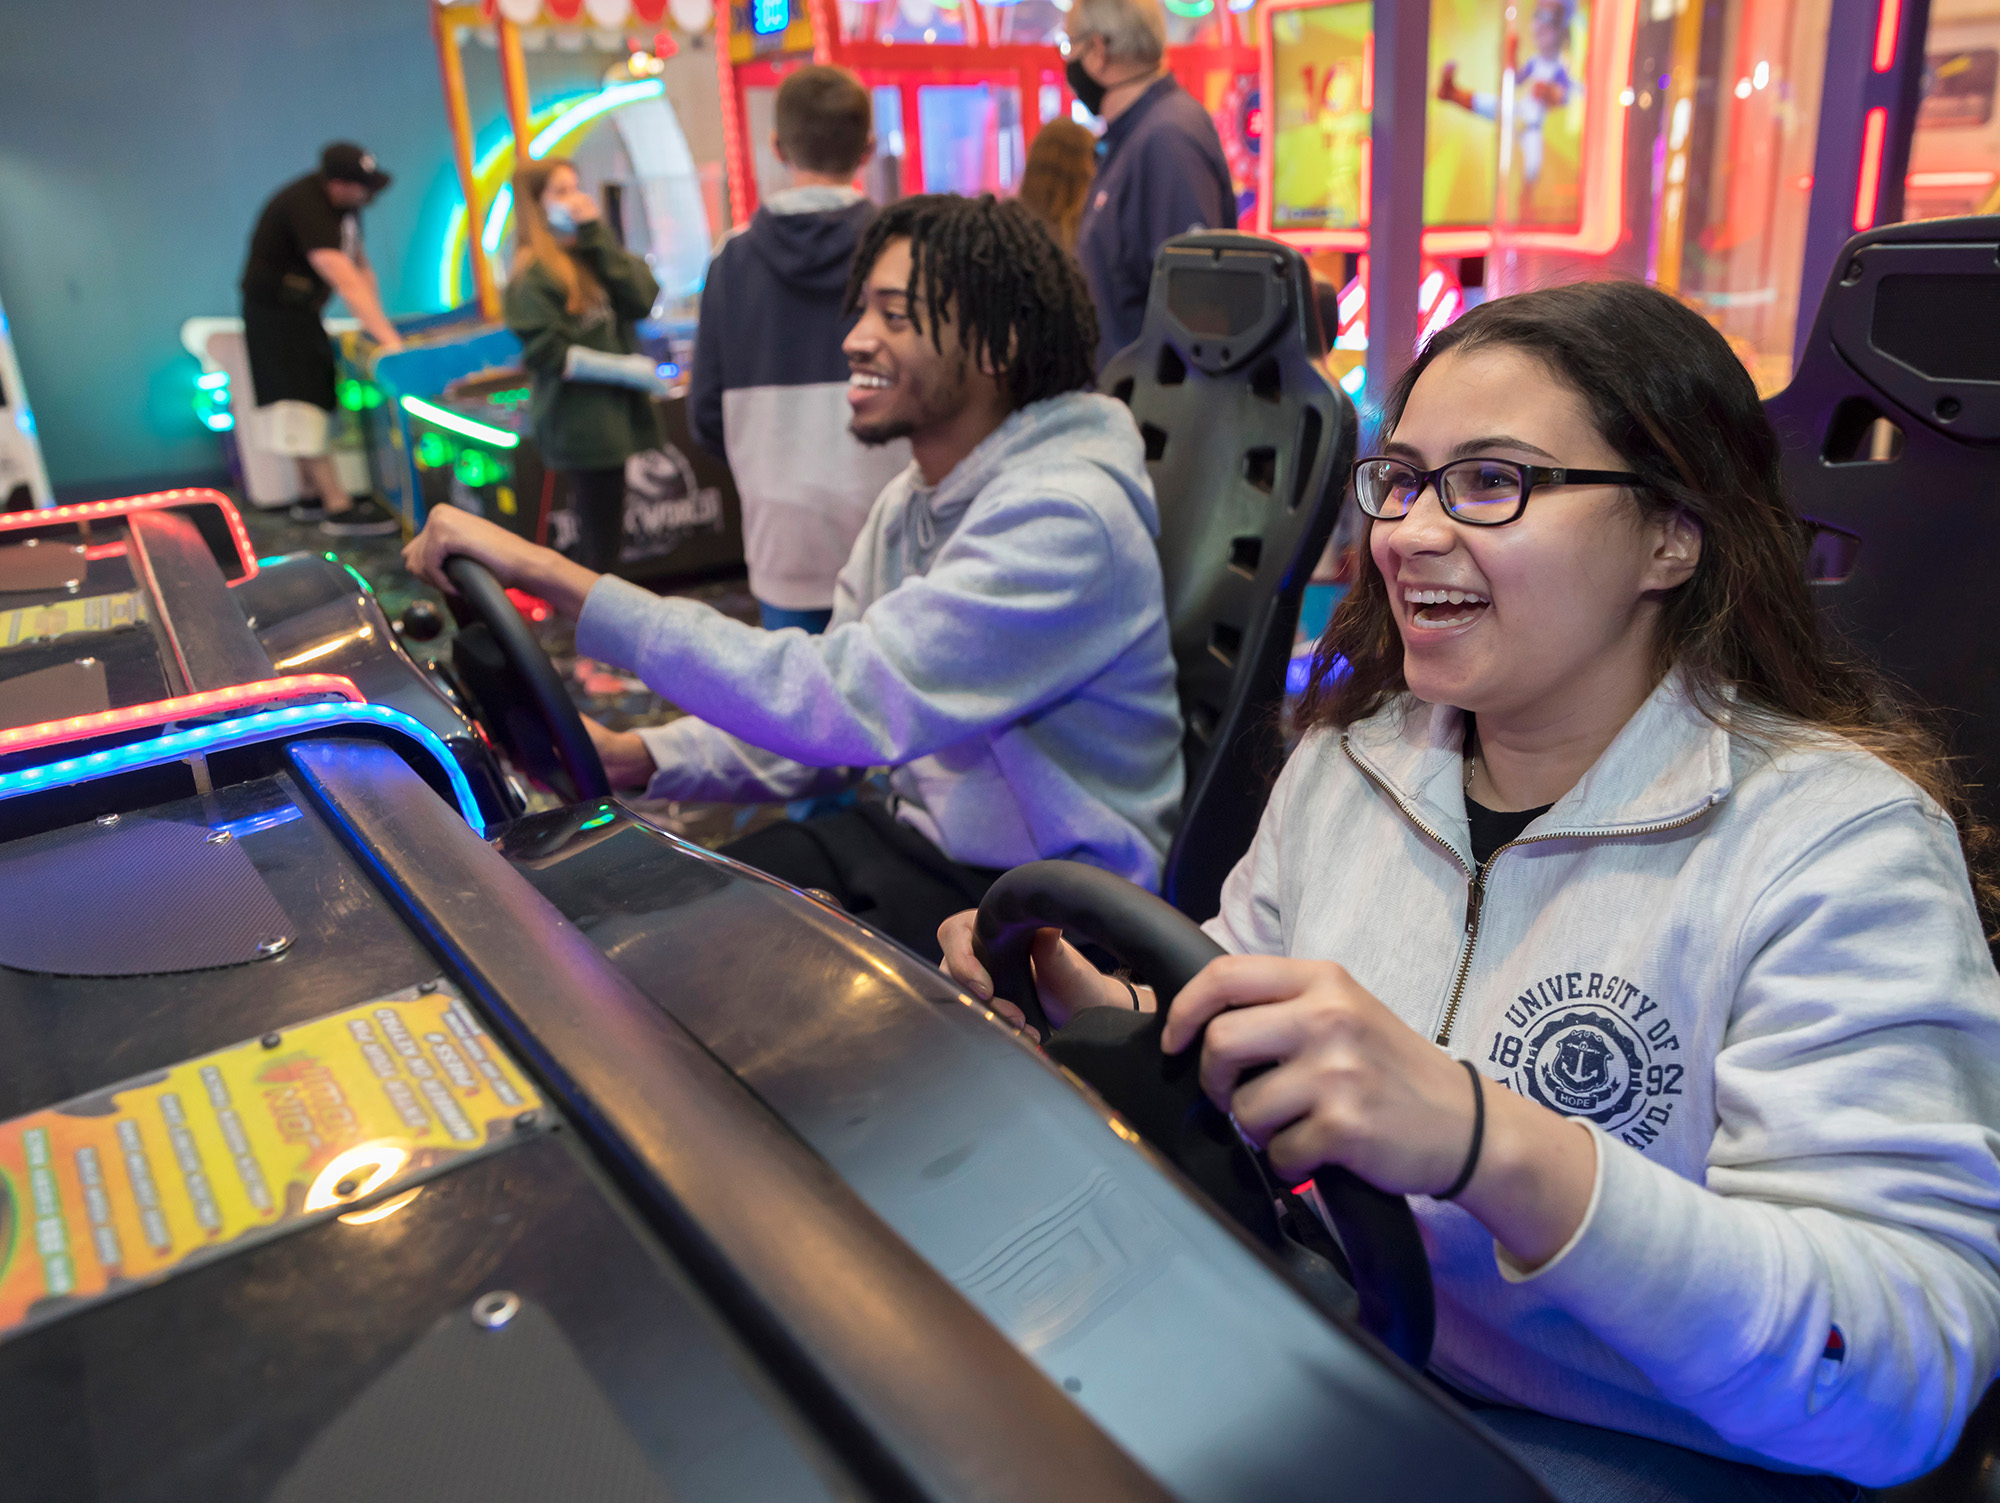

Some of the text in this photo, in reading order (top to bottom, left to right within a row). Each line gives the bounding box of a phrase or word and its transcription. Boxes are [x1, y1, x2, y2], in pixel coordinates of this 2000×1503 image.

[1504, 972, 1680, 1052] UNIVERSITY OF
[1488, 1031, 1523, 1068] 18
[1646, 1063, 1684, 1097] 92
[1560, 1093, 1590, 1108] HOPE
